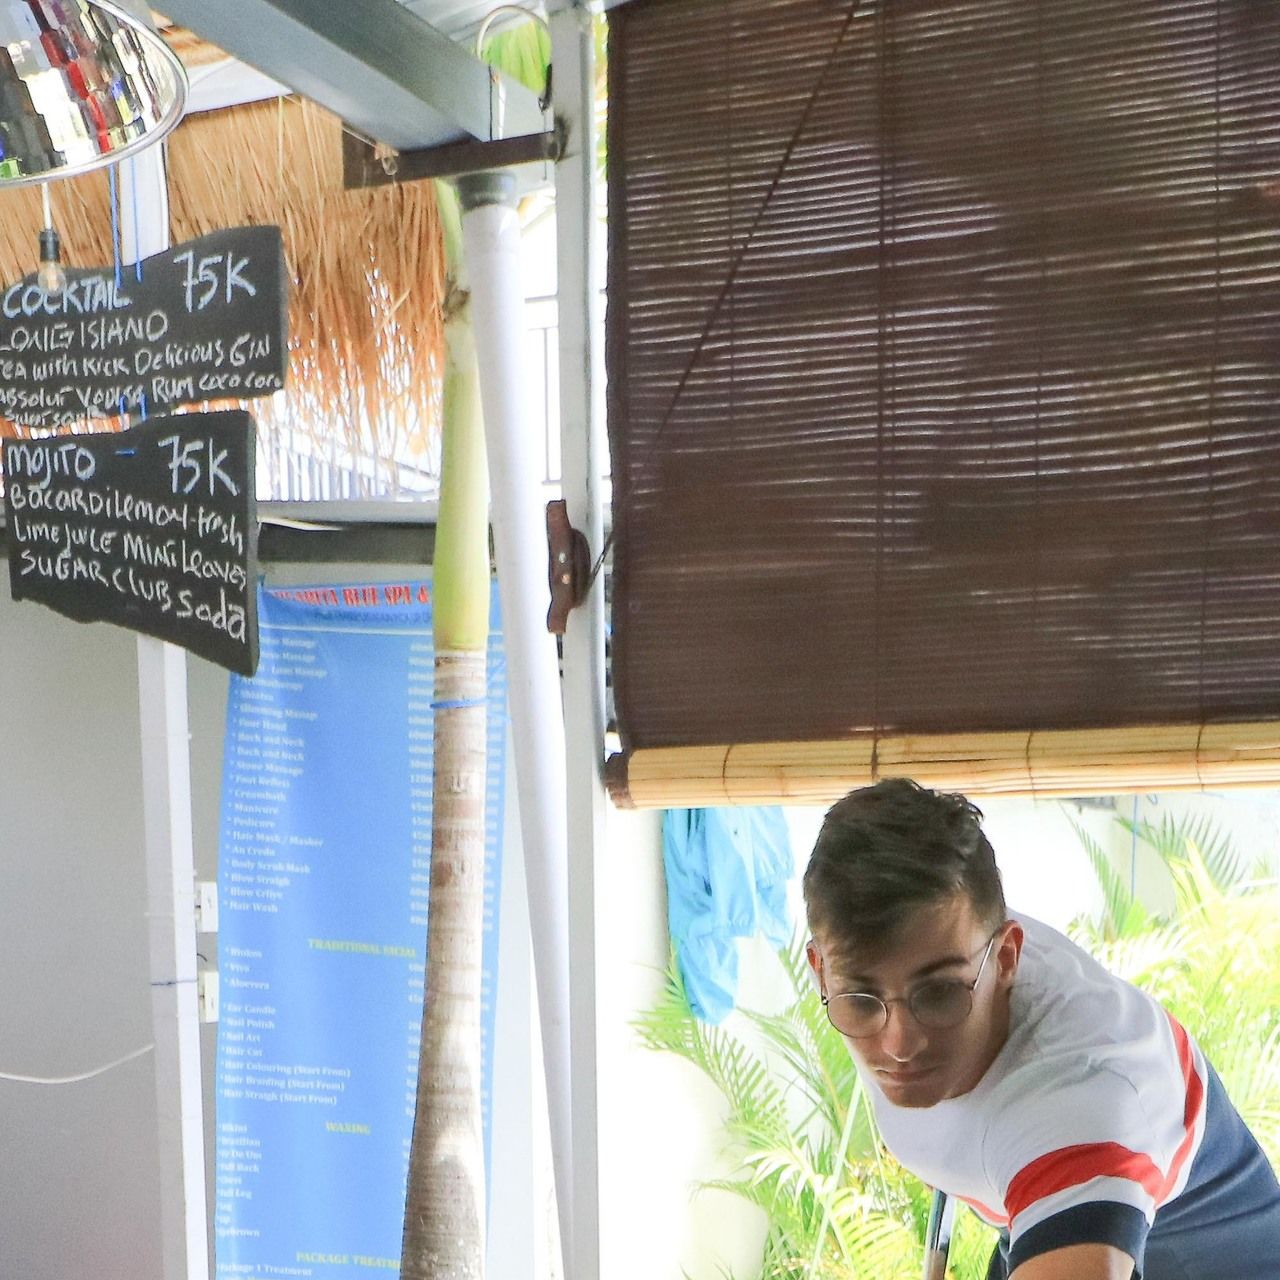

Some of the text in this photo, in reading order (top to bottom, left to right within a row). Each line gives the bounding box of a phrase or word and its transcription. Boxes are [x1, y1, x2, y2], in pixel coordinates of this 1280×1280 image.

[2, 250, 256, 319] COCKTAIL 75K
[158, 435, 241, 497] 75K
[295, 1251, 402, 1271] PACKAGE TREATM
